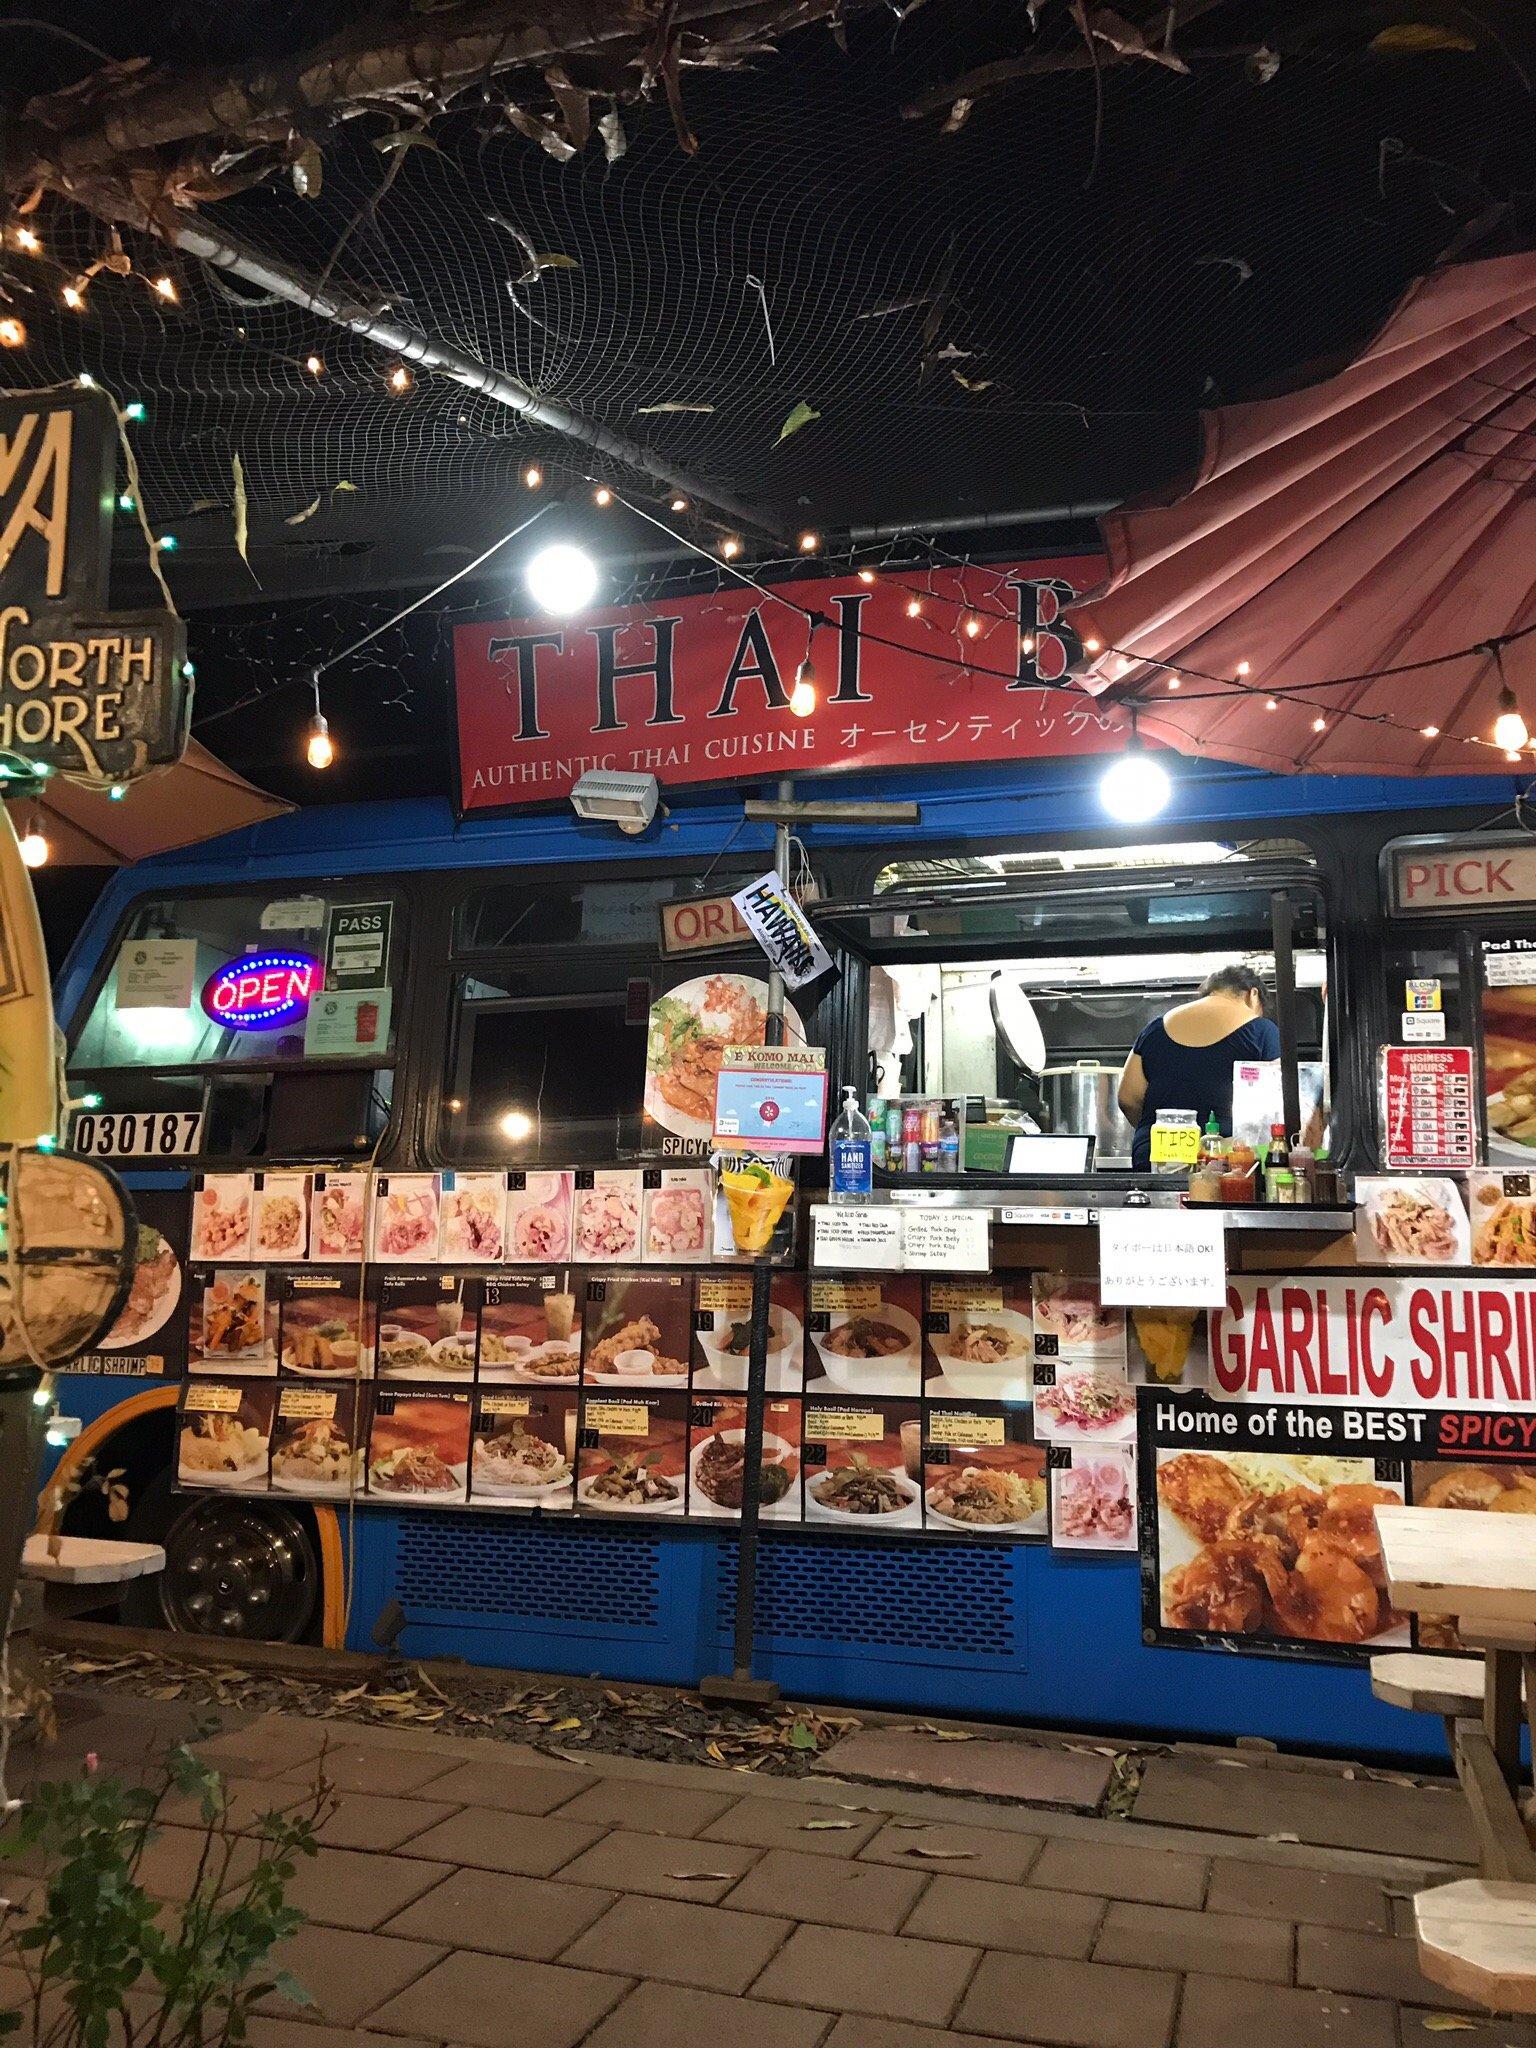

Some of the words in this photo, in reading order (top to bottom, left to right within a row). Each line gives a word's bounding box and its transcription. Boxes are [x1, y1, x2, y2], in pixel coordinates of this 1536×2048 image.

[488, 592, 873, 742] THAI
[471, 753, 617, 789] AUTHENTIC
[628, 744, 691, 772] THAI
[704, 728, 816, 760] CUISINE
[1405, 858, 1515, 899] PICK
[338, 914, 383, 933] PASS
[1481, 939, 1511, 951] Pad
[213, 966, 313, 1012] OPEN
[747, 1051, 784, 1063] KOMO
[787, 1053, 815, 1064] MAI
[1402, 1053, 1455, 1063] BUSINESS
[76, 1113, 201, 1155] 030187
[1156, 1130, 1197, 1147] TIPS
[663, 1138, 702, 1155] SPICY
[841, 1152, 864, 1163] HAND
[510, 1173, 525, 1189] 12
[484, 1287, 500, 1305] 13
[588, 1283, 604, 1301] 16
[695, 1312, 713, 1330] 19
[809, 1312, 830, 1331] 21
[1035, 1336, 1058, 1355] 25
[1211, 1285, 1395, 1398] GARLIC
[65, 1356, 100, 1373] ARLIC
[105, 1356, 146, 1374] SHRIMP
[1035, 1365, 1055, 1385] 26
[478, 1414, 494, 1432] 14
[691, 1407, 712, 1426] 20
[1155, 1403, 1238, 1435] Home
[1247, 1407, 1277, 1437] of
[1285, 1409, 1334, 1440] the
[1343, 1411, 1428, 1443] BEST
[1439, 1413, 1536, 1448] SPICY
[582, 1430, 598, 1448] 17
[806, 1444, 826, 1464] 22
[926, 1444, 948, 1464] 24
[1050, 1447, 1071, 1468] 27
[1375, 1459, 1401, 1481] 30
